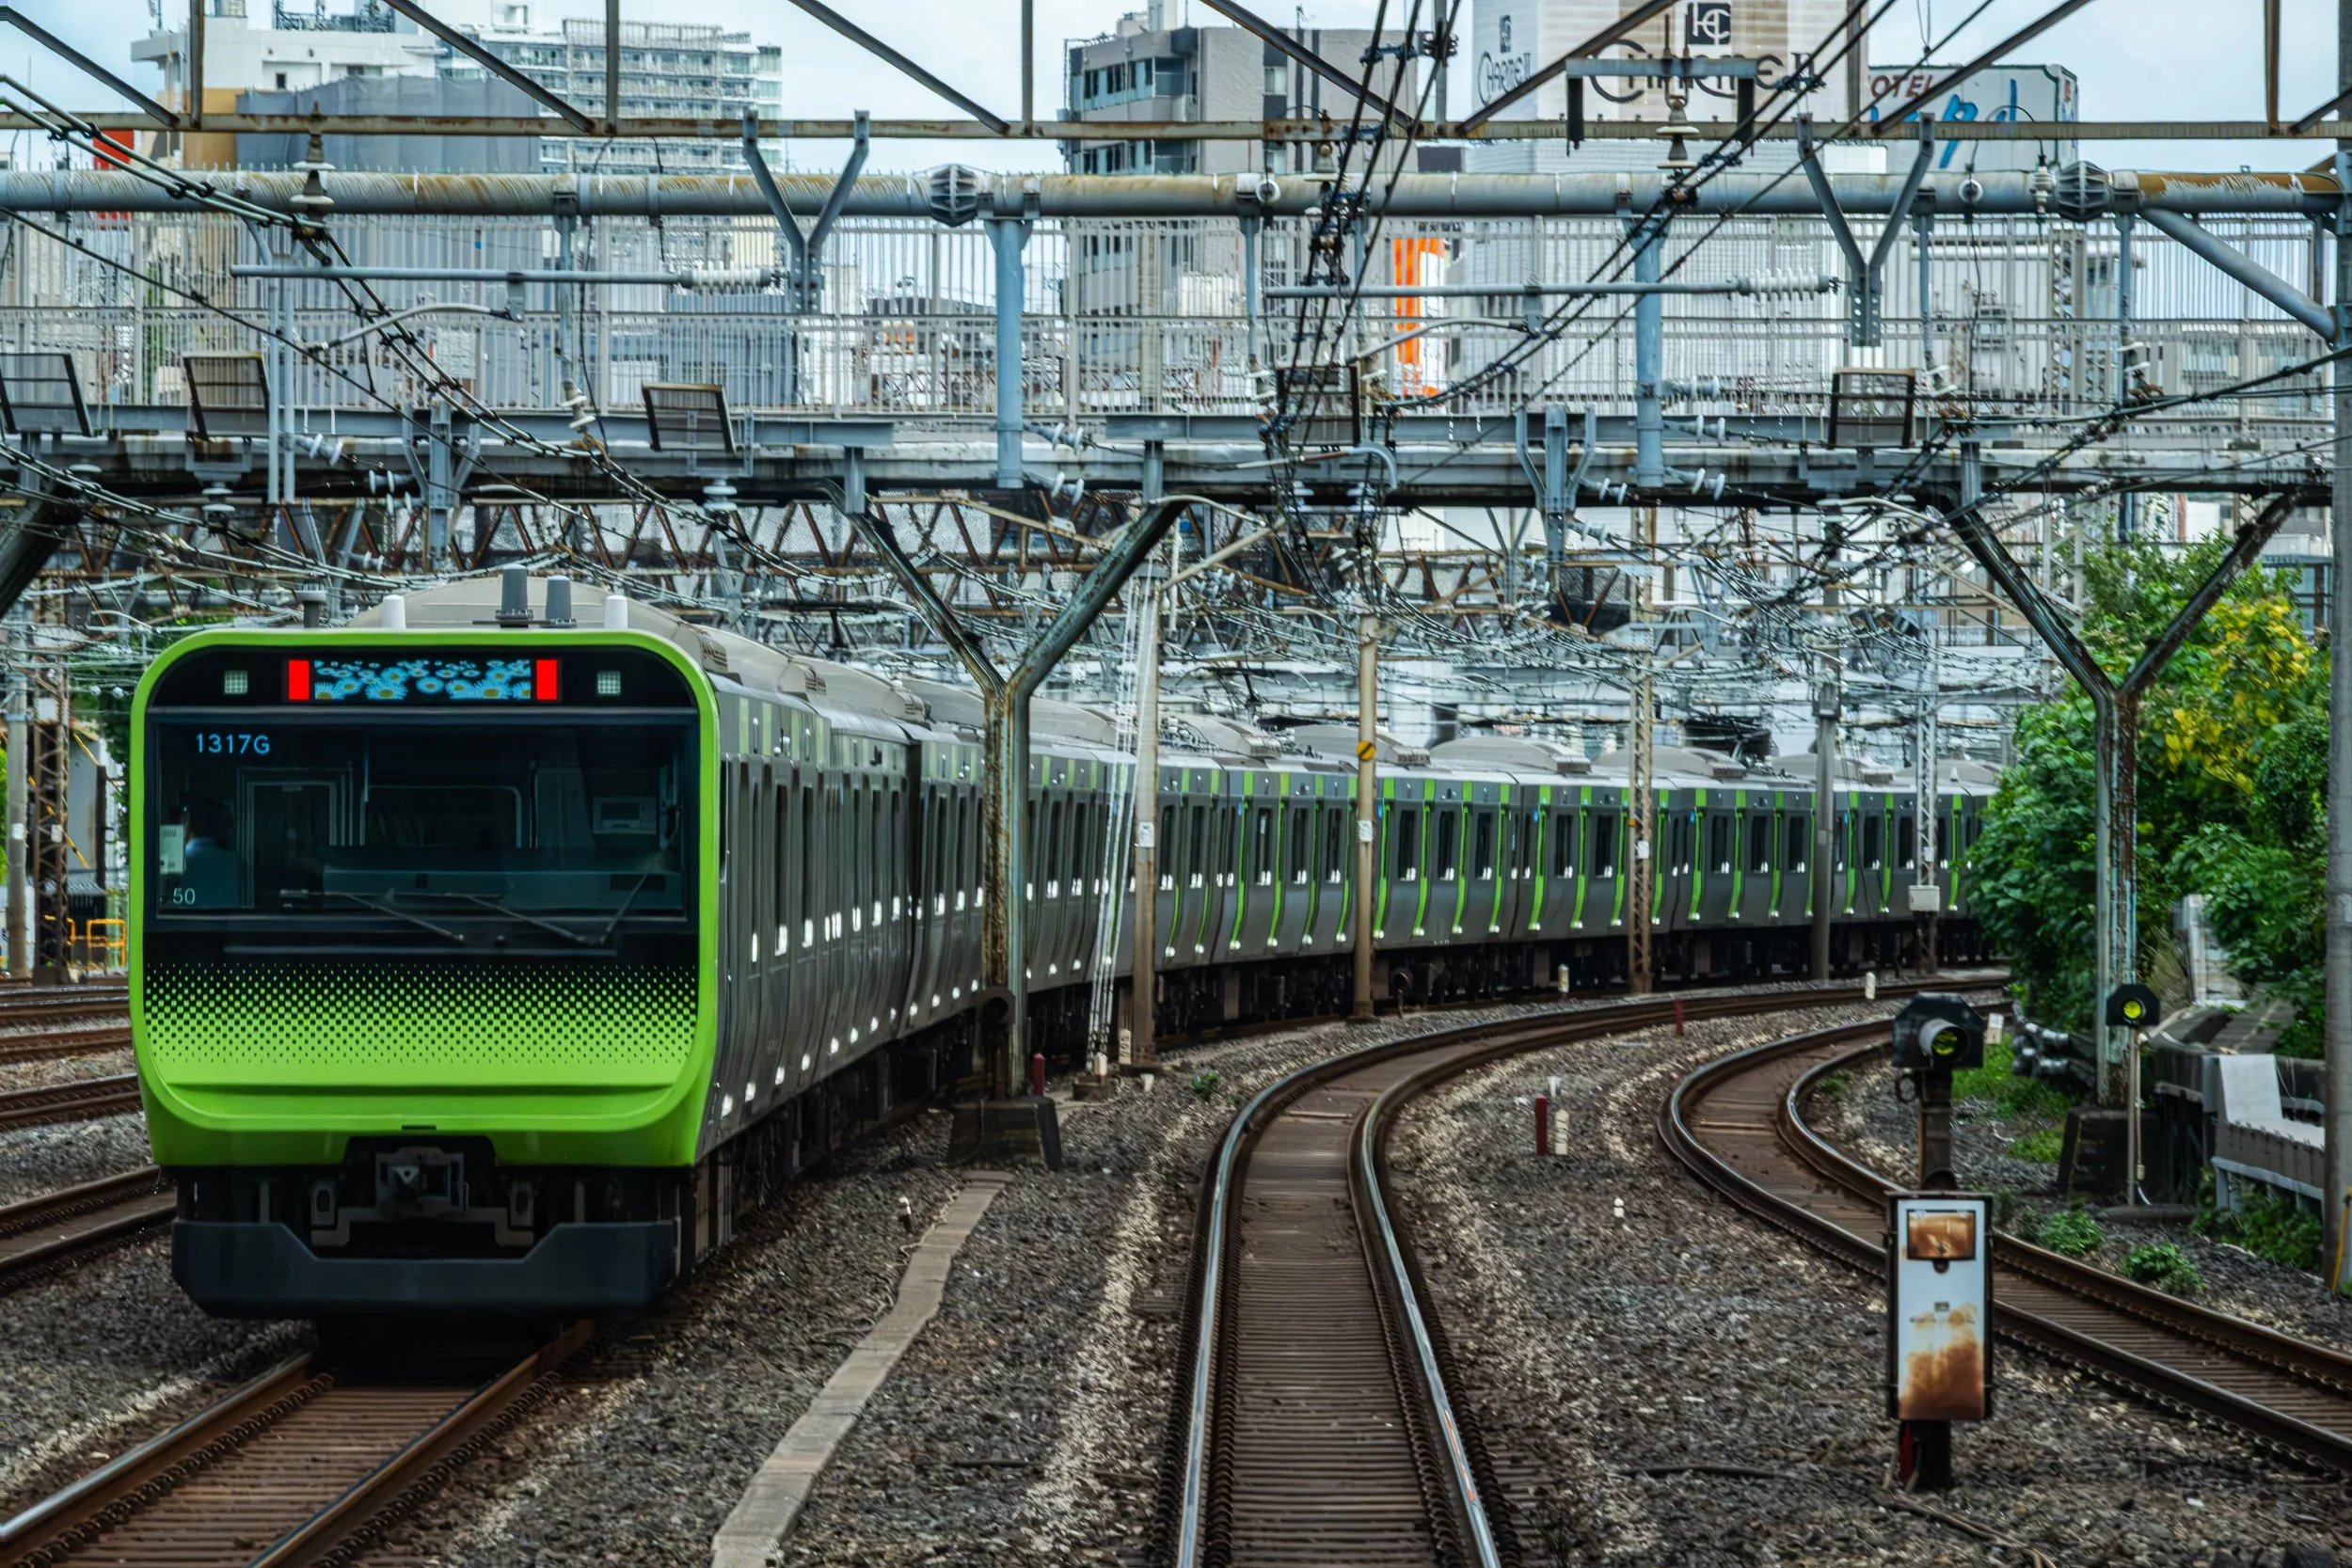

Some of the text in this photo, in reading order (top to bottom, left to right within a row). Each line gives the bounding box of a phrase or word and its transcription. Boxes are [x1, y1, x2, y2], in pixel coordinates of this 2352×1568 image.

[1867, 74, 1933, 99] OTEL
[196, 733, 270, 754] 1317G
[173, 887, 196, 905] 50
